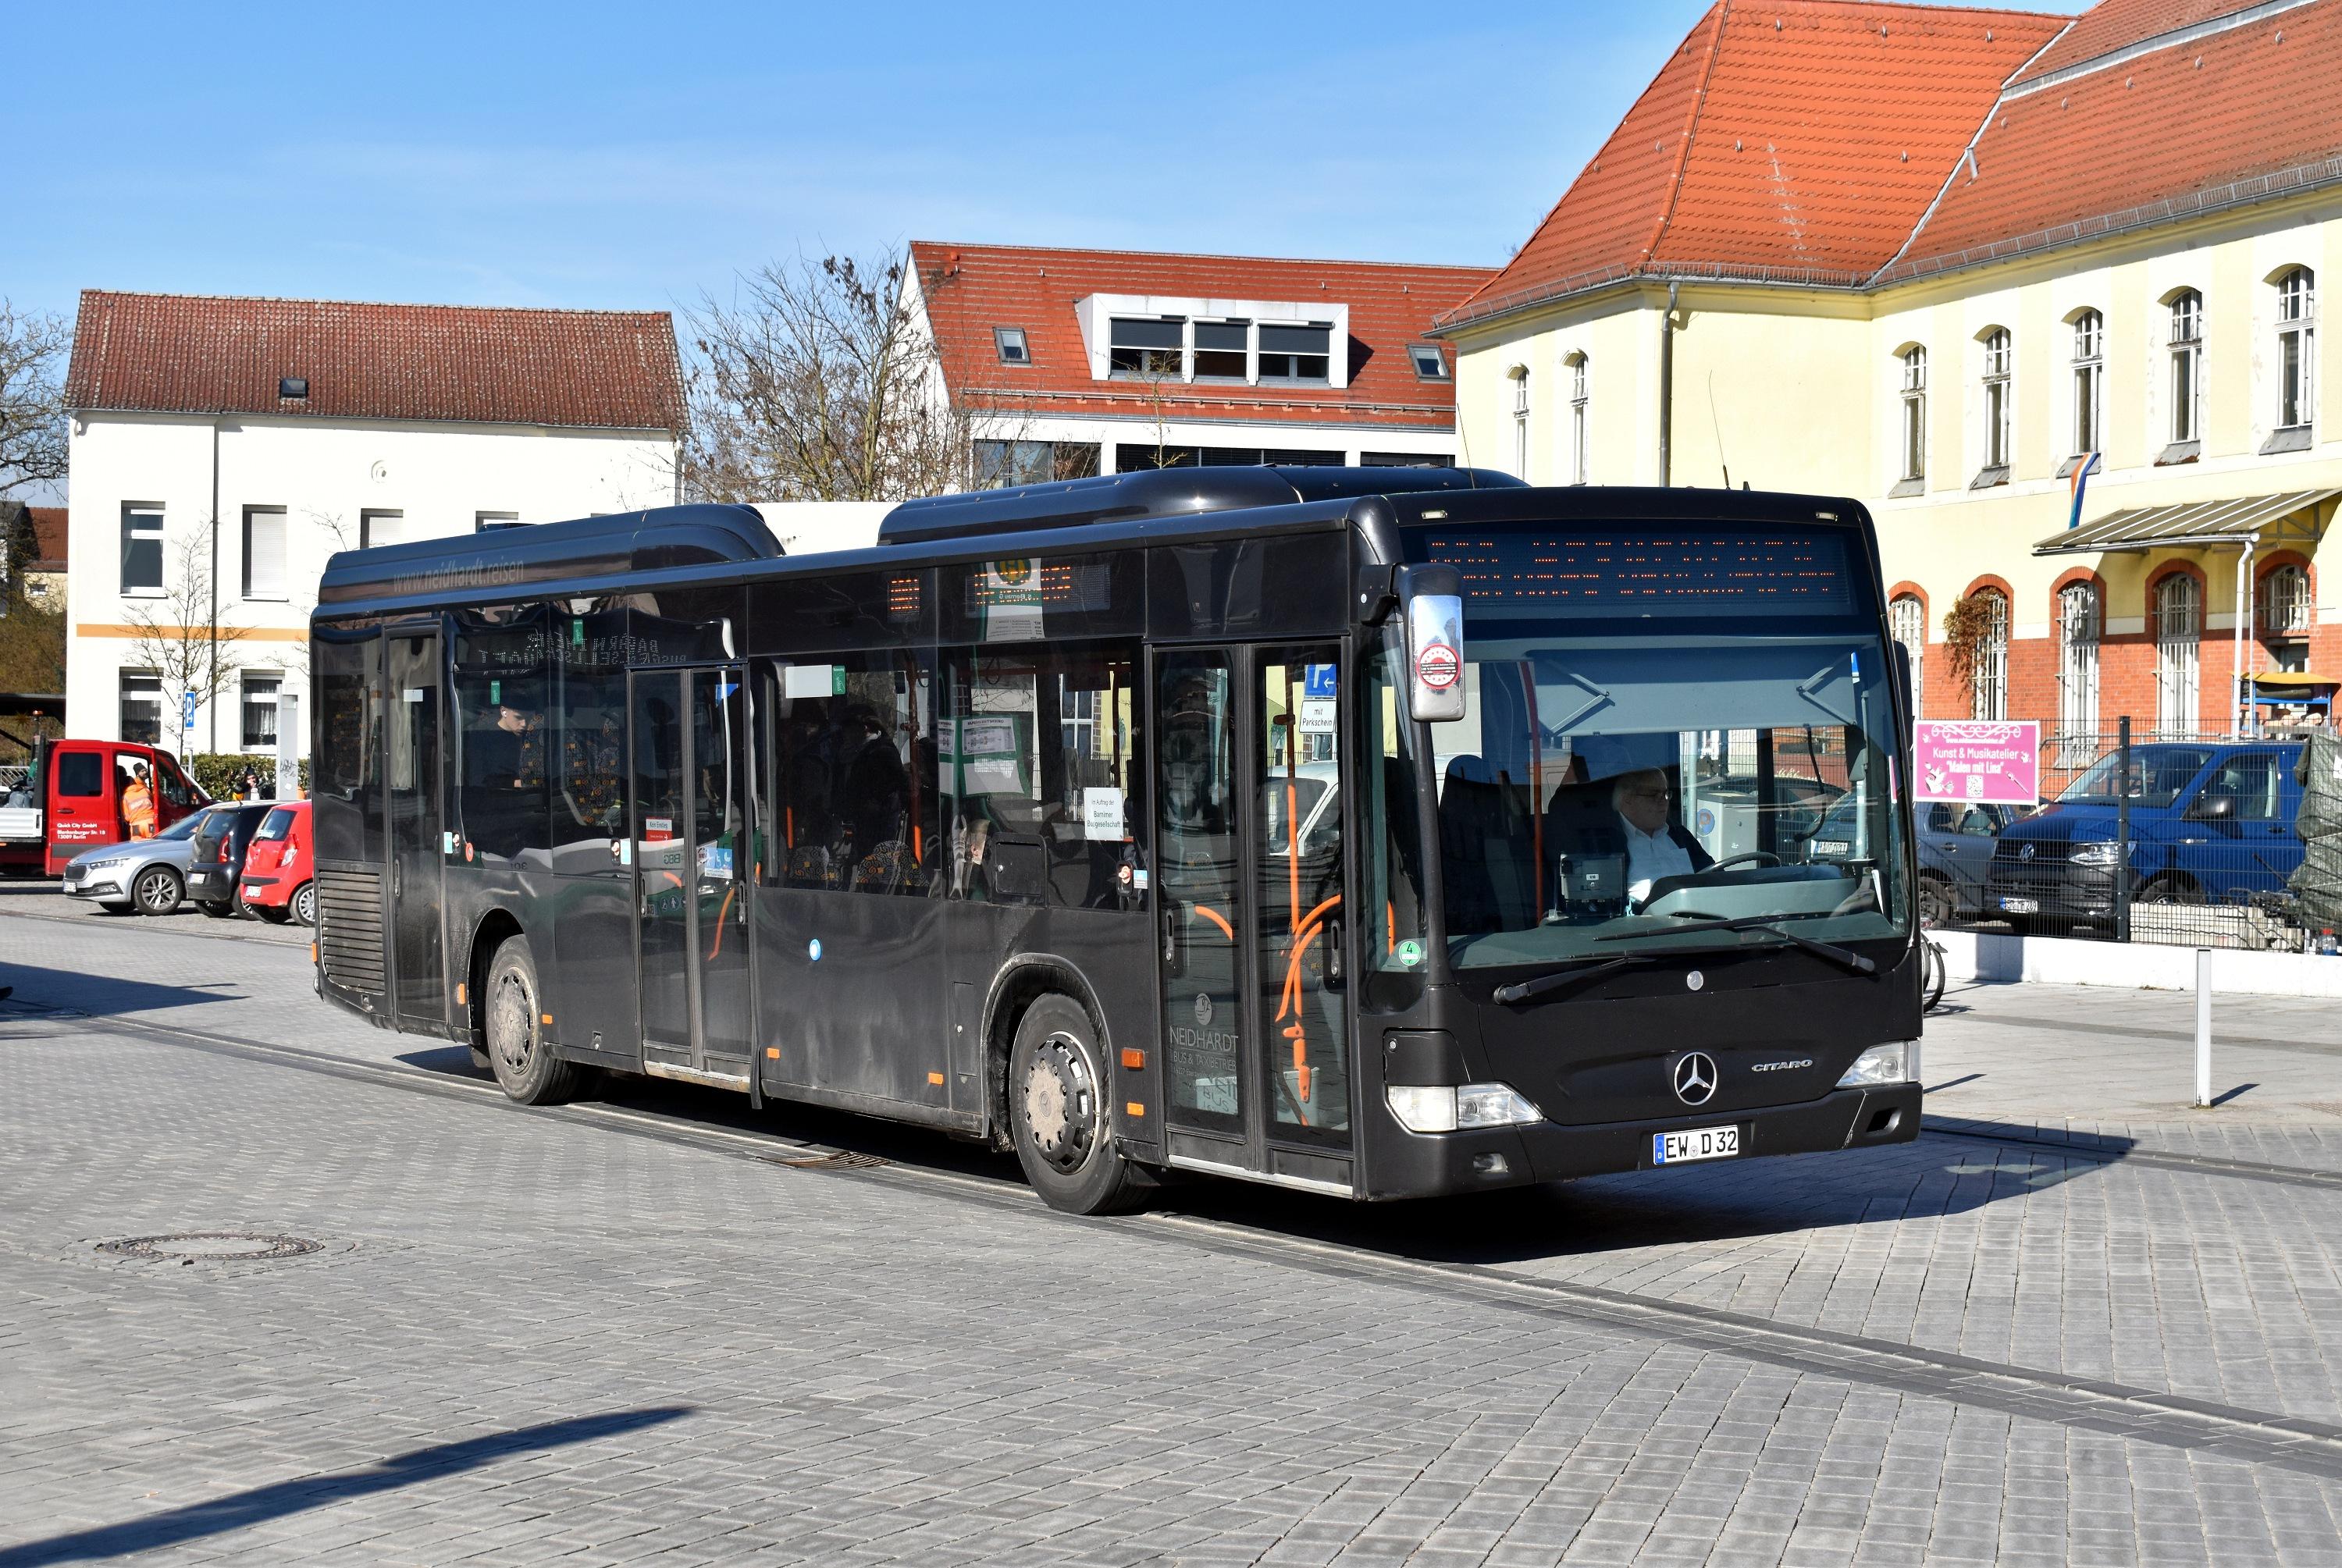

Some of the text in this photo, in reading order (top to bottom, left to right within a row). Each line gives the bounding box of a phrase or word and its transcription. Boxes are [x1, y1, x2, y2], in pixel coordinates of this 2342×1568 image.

[393, 556, 524, 592] www.neidhardt.reisen
[1302, 717, 1333, 727] Parkschein
[1932, 747, 2019, 760] Kunst & Musikatelier
[1972, 762, 1984, 773] mit
[1407, 943, 1413, 953] 4
[1169, 1026, 1239, 1053] NEIDHARDT
[1173, 1051, 1187, 1063] BUS
[1188, 1054, 1194, 1065] &
[1751, 1059, 1813, 1072] CITARO
[1666, 1136, 1689, 1159] EW
[1700, 1133, 1712, 1155] D
[1717, 1130, 1737, 1153] 32
